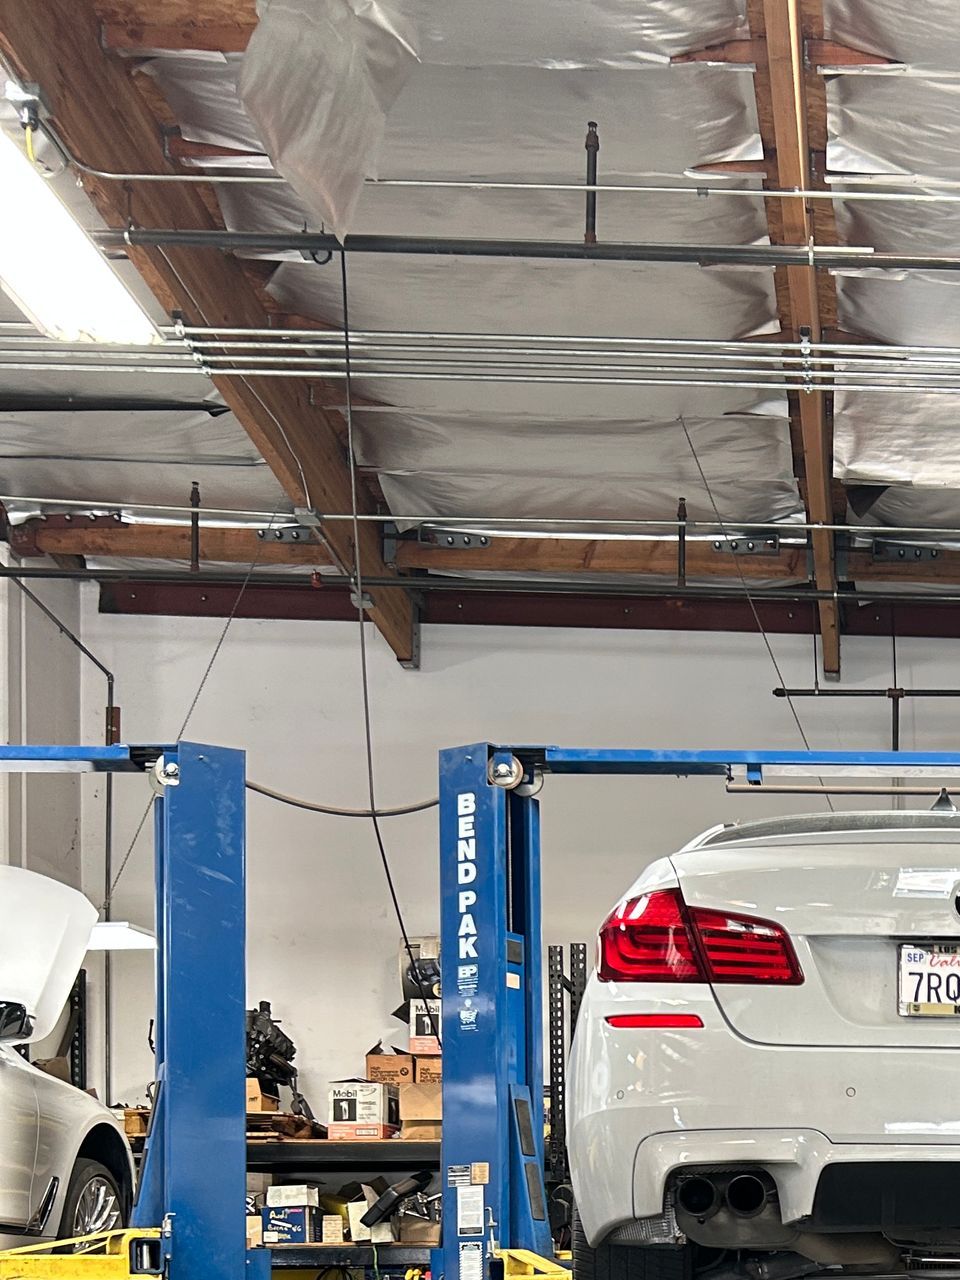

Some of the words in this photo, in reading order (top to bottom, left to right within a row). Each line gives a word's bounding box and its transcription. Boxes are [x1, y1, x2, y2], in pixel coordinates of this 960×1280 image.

[457, 792, 477, 885] BEND
[458, 891, 478, 959] PAK
[939, 946, 957, 954] LOS
[907, 953, 924, 963] SEP
[333, 1089, 357, 1098] Mobil
